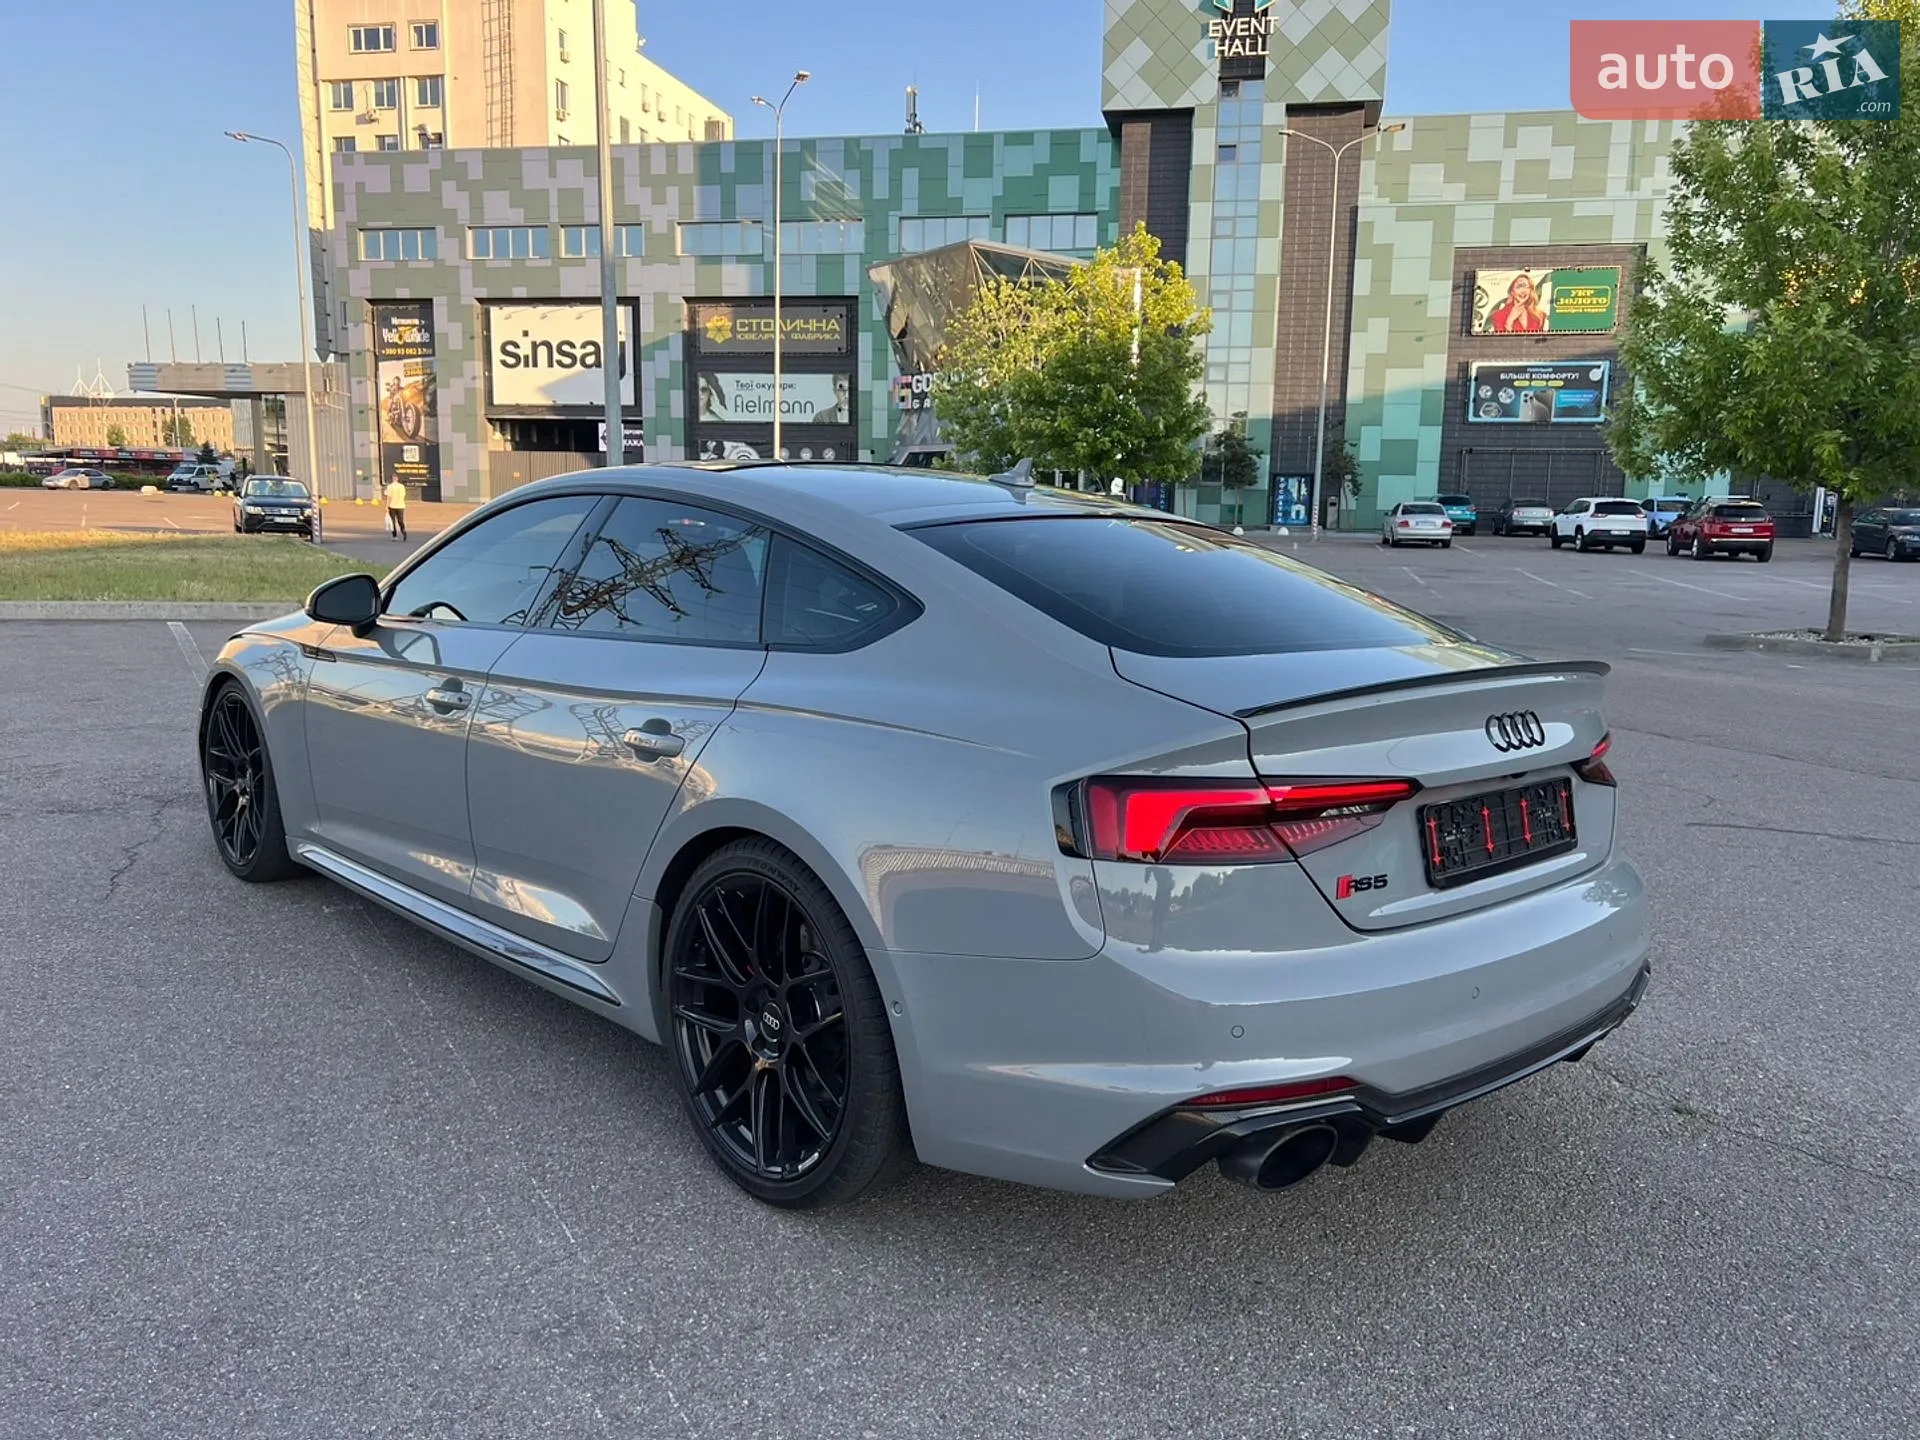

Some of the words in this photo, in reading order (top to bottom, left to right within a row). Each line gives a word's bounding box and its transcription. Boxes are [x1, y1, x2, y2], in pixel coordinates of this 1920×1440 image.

[1209, 16, 1279, 37] EVENT
[1214, 36, 1270, 57] HALL
[1570, 289, 1595, 297] УКР
[791, 332, 841, 341] ФАБРИКА
[1336, 874, 1388, 900] RS5
